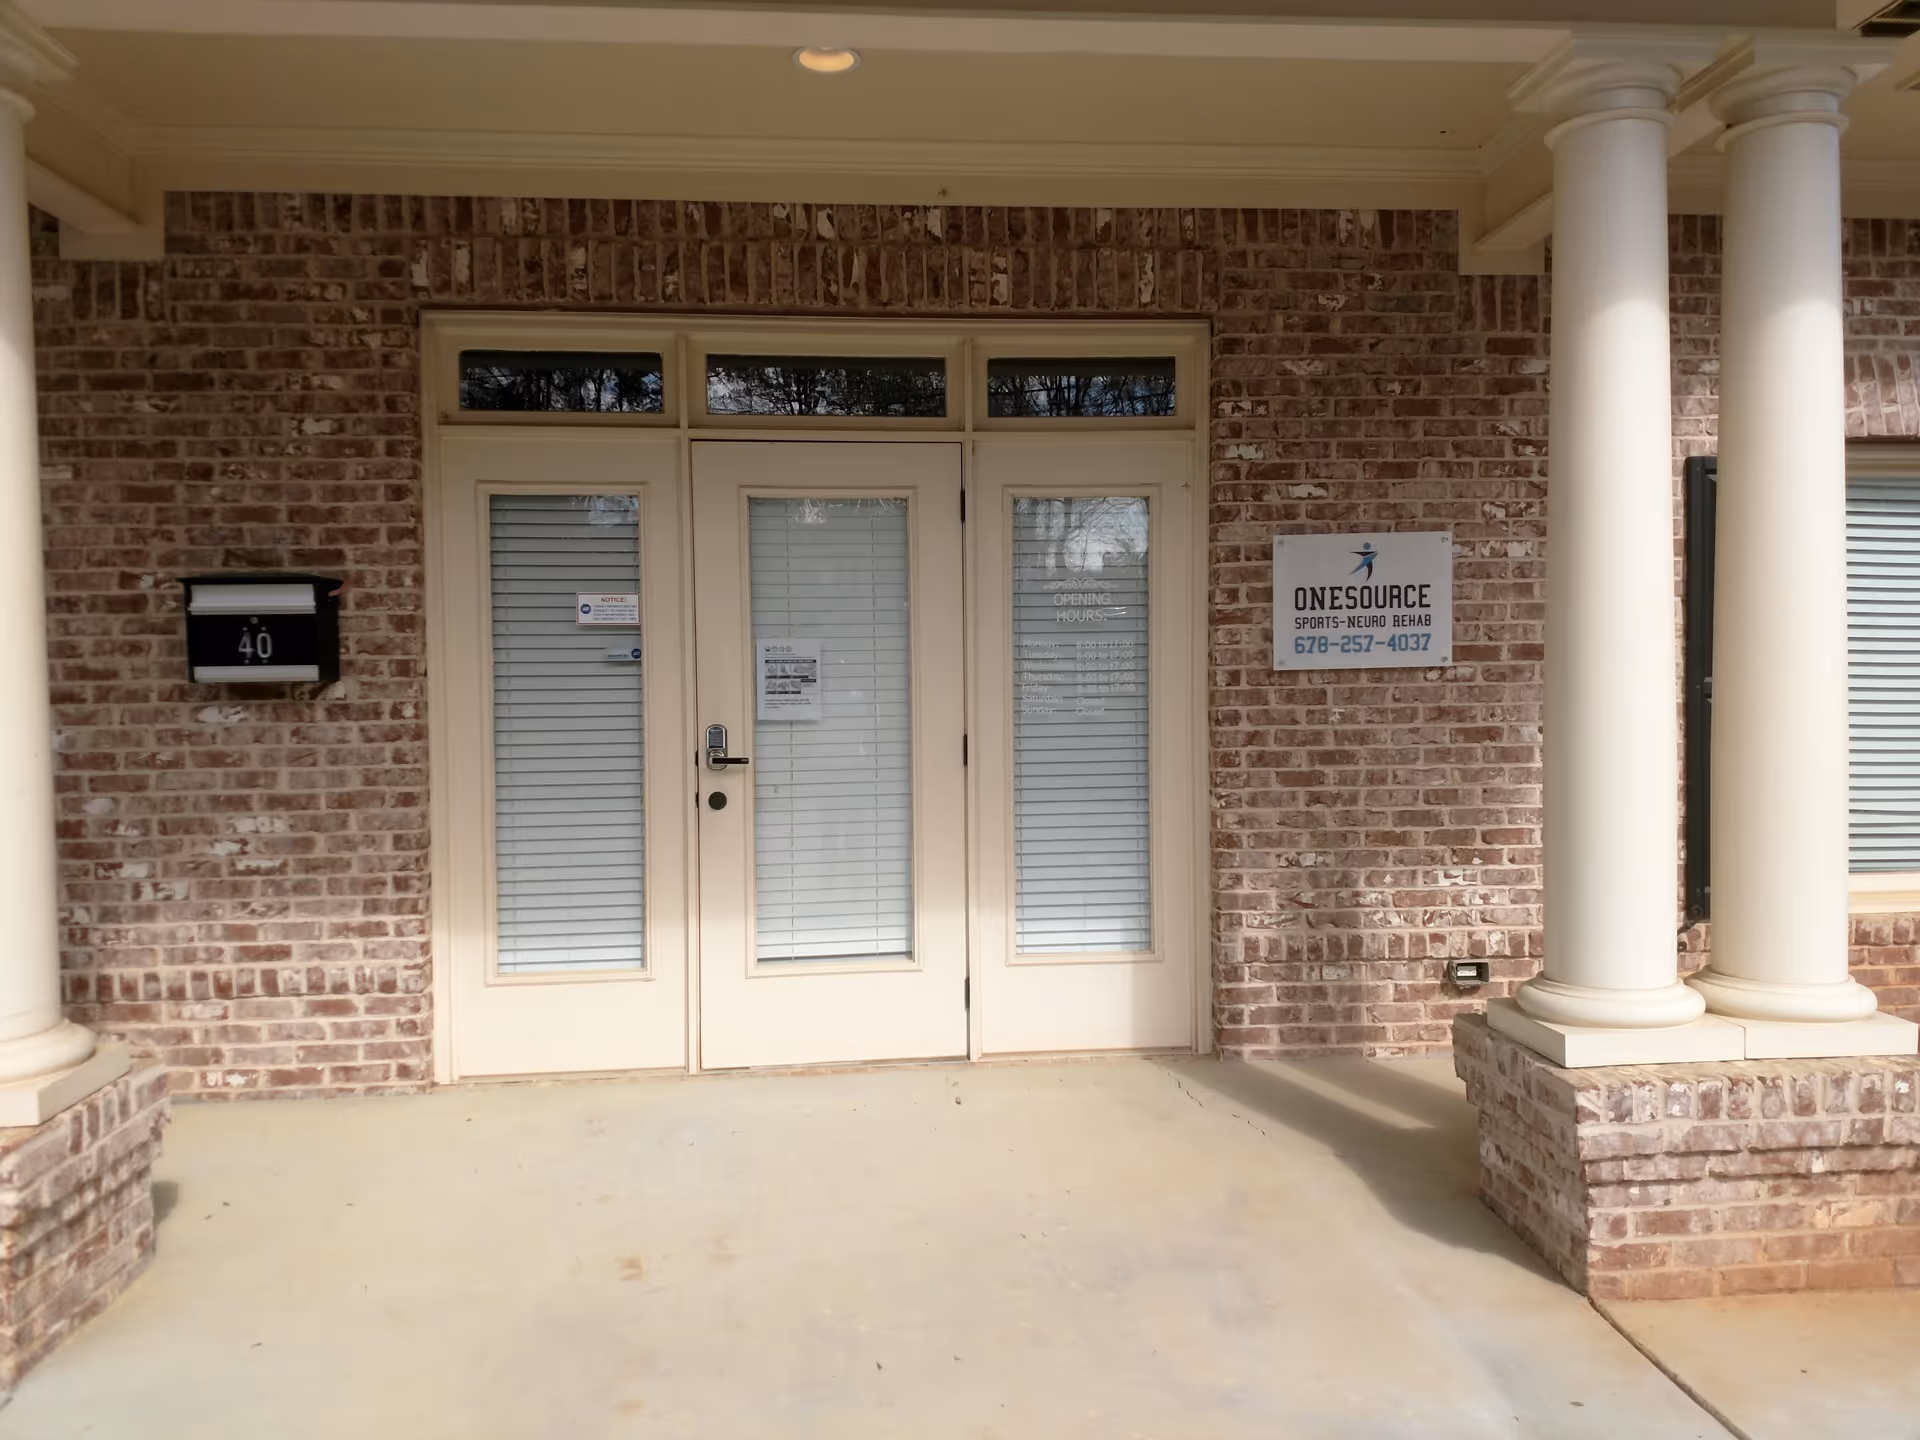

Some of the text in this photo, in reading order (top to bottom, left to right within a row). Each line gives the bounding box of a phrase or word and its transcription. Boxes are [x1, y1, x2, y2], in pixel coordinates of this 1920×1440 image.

[1053, 593, 1111, 606] OPENING
[1294, 584, 1431, 611] ONESOURCE
[1294, 614, 1431, 630] SPORTS-NEURO REHAB
[237, 632, 273, 659] 40
[1294, 633, 1431, 654] 678-257-4037
